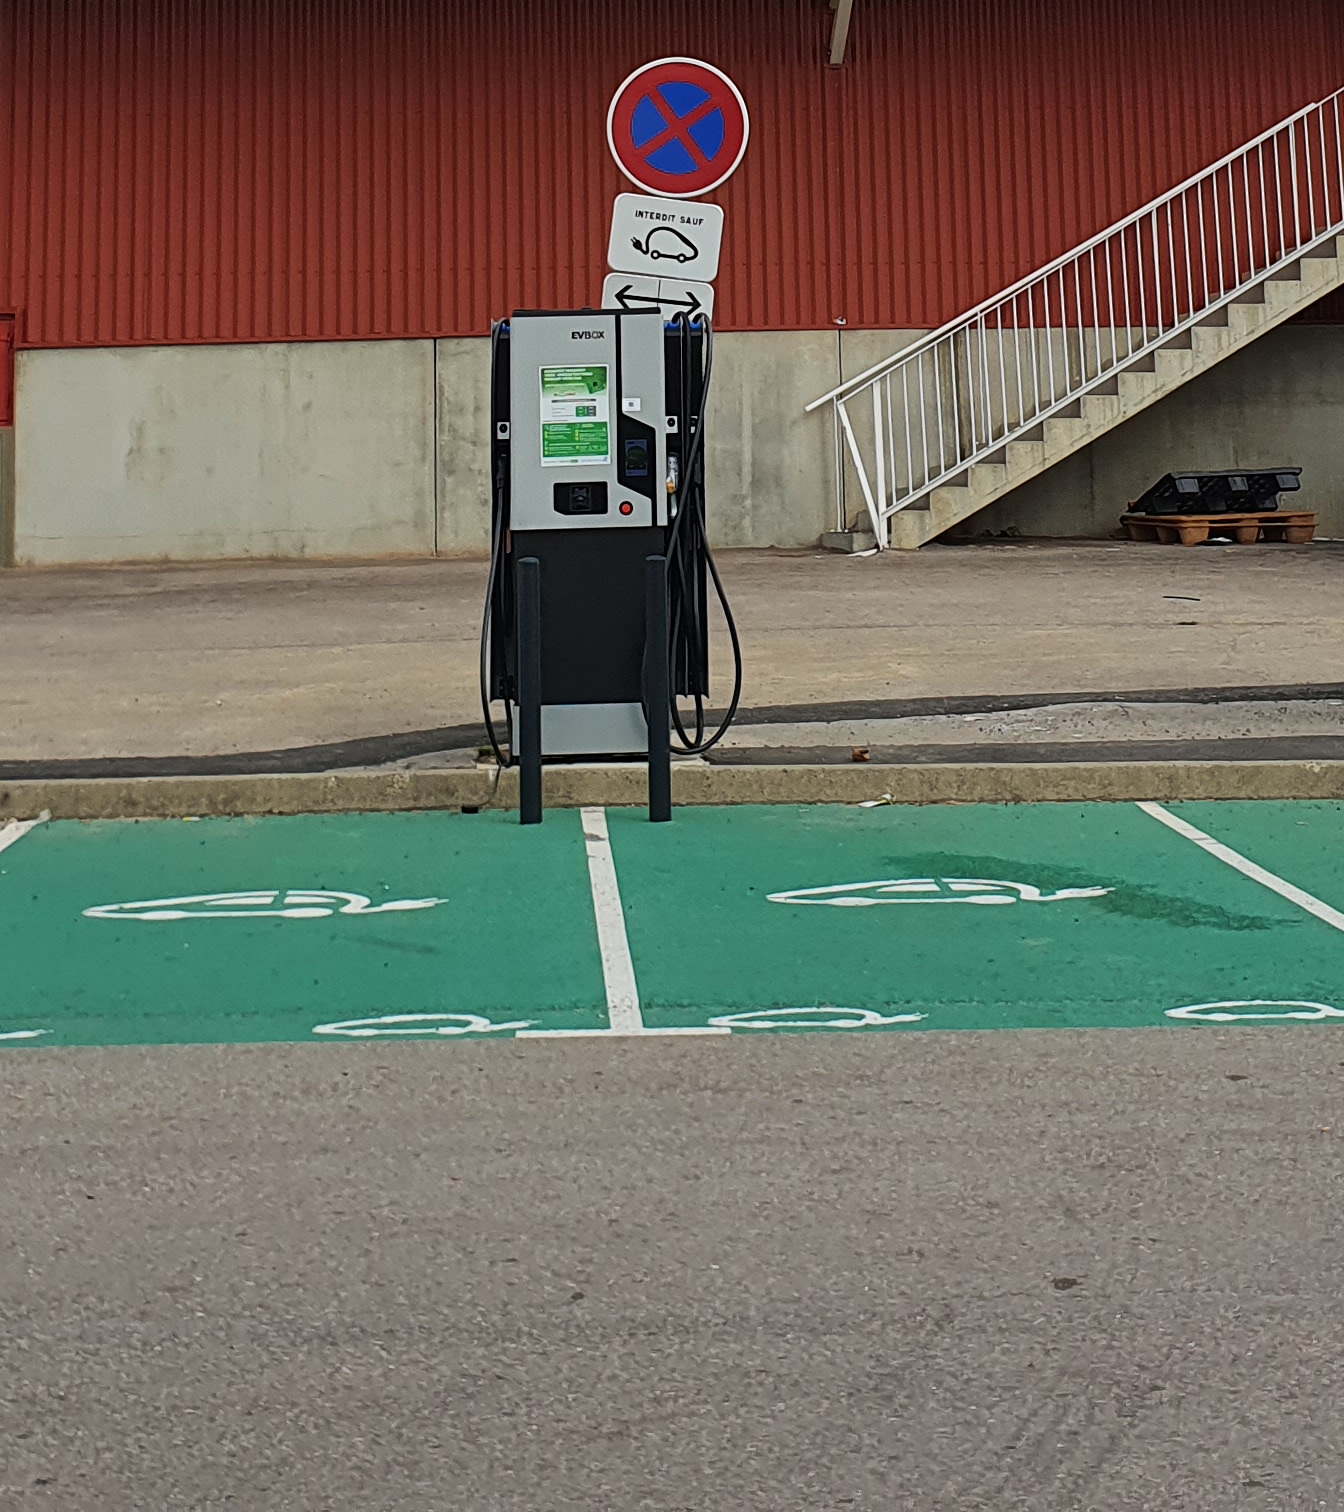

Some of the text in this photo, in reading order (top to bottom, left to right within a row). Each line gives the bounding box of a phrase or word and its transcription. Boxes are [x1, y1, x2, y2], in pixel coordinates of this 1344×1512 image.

[635, 209, 704, 226] INTERDIT SAUF
[571, 330, 605, 339] EVBOX
